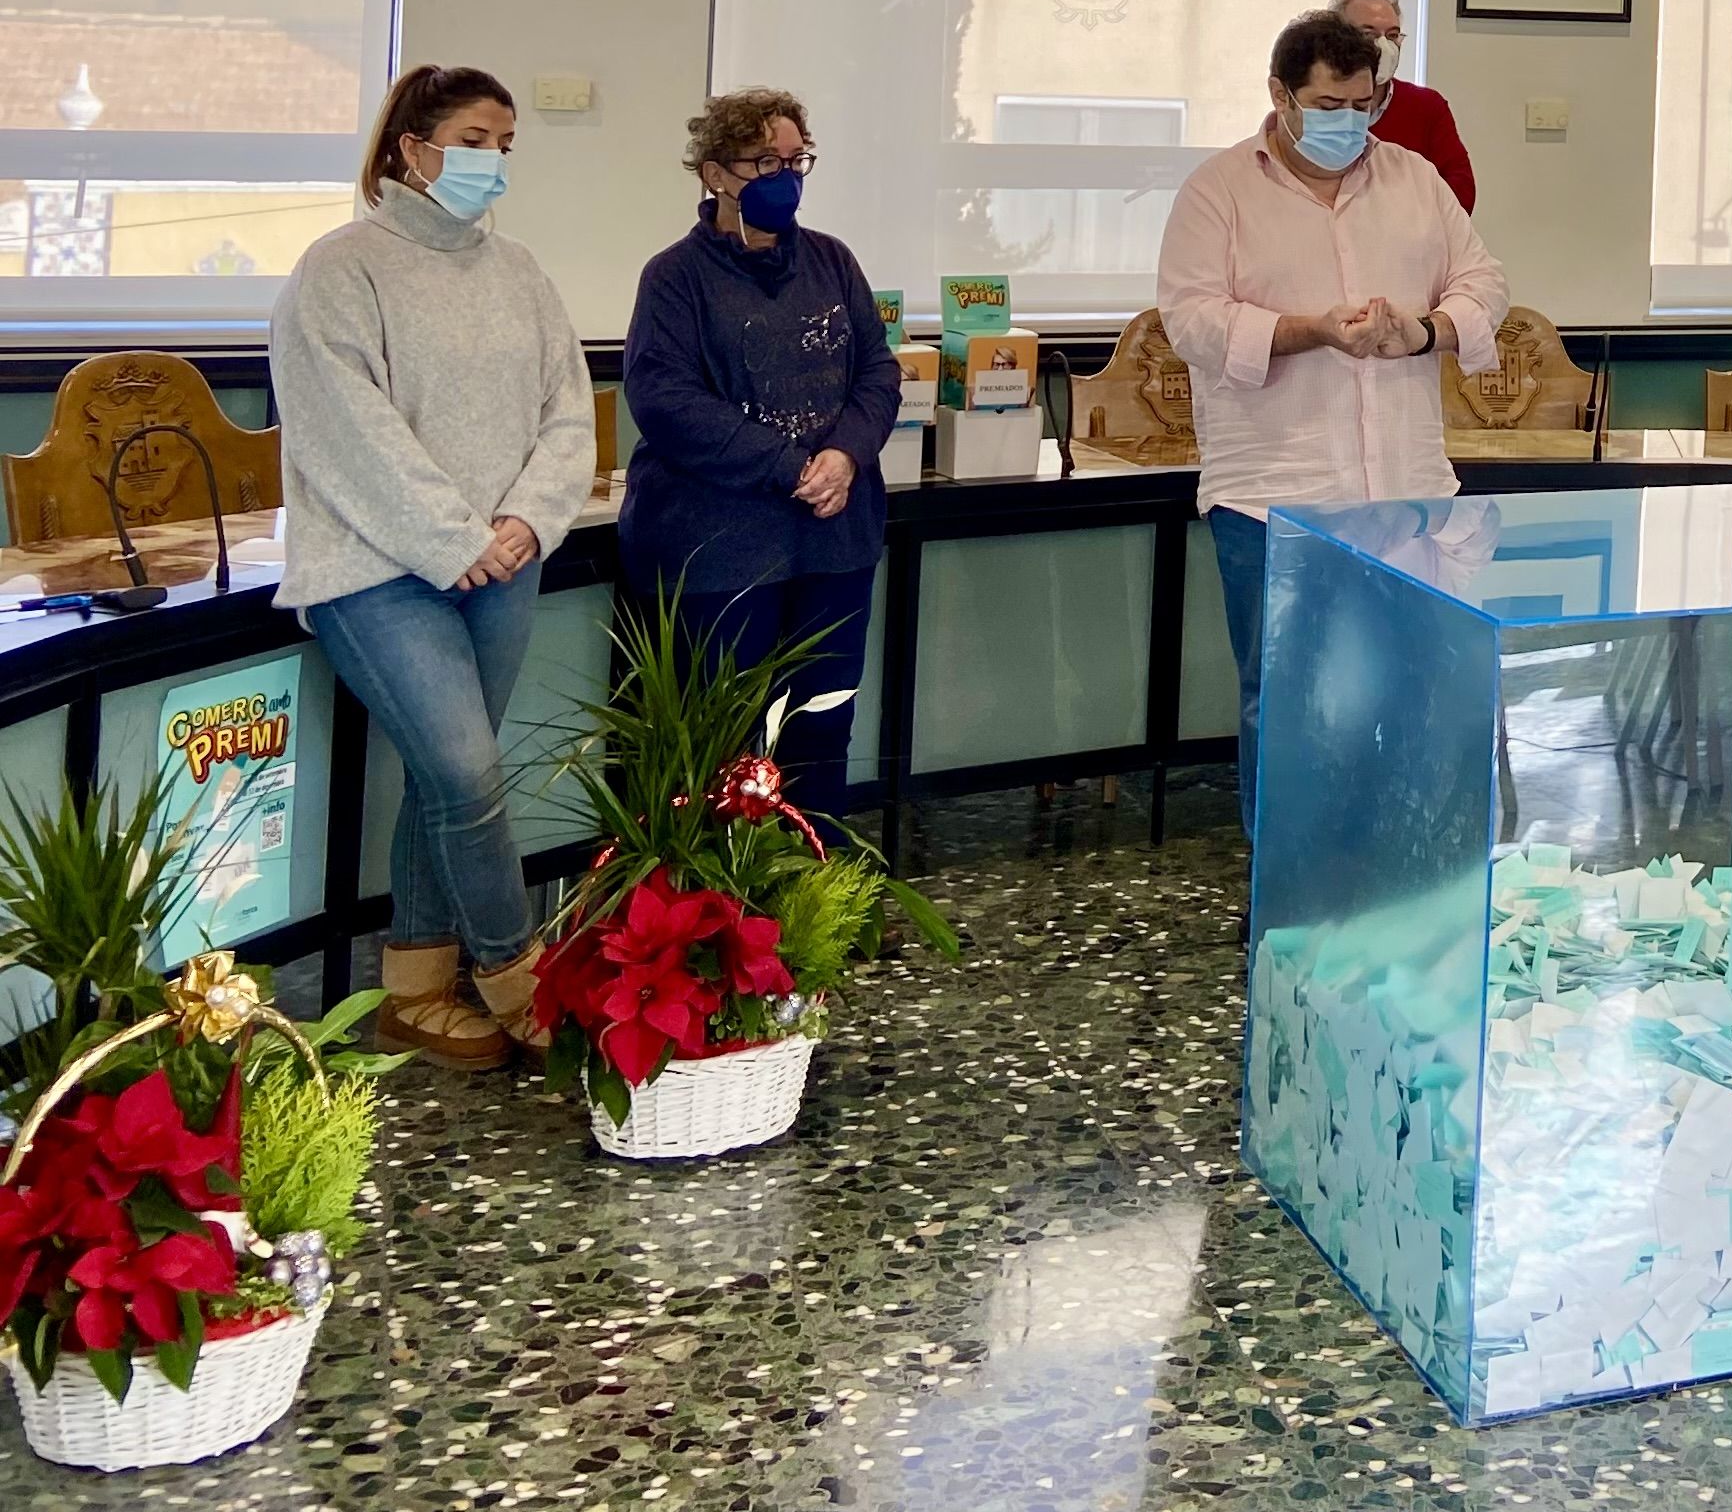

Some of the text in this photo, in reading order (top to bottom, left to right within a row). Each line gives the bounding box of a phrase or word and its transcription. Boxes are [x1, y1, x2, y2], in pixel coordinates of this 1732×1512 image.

[957, 291, 1005, 309] PREMI
[167, 688, 291, 749] COMERÇ amb
[187, 714, 288, 784] PREMI
